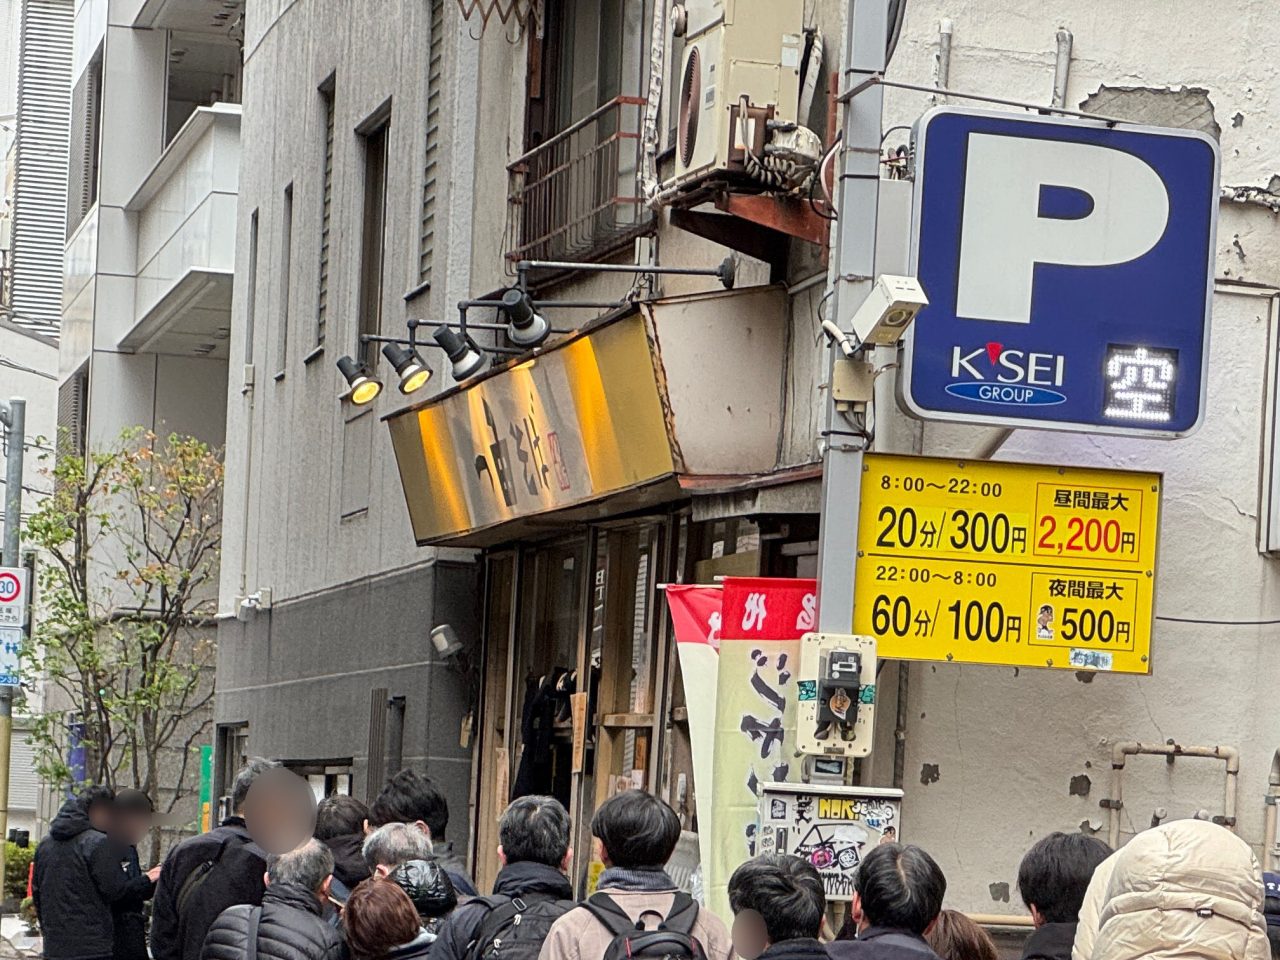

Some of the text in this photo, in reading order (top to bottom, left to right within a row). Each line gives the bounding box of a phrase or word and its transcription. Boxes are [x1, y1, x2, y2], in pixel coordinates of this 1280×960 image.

[956, 132, 1170, 324] P
[978, 385, 1034, 403] GROUP
[1104, 348, 1174, 421] 空
[1053, 489, 1129, 512] 昼間最大
[1037, 515, 1136, 555] 2,200円
[1049, 578, 1124, 601] 夜間最大
[1060, 608, 1130, 643] 500円
